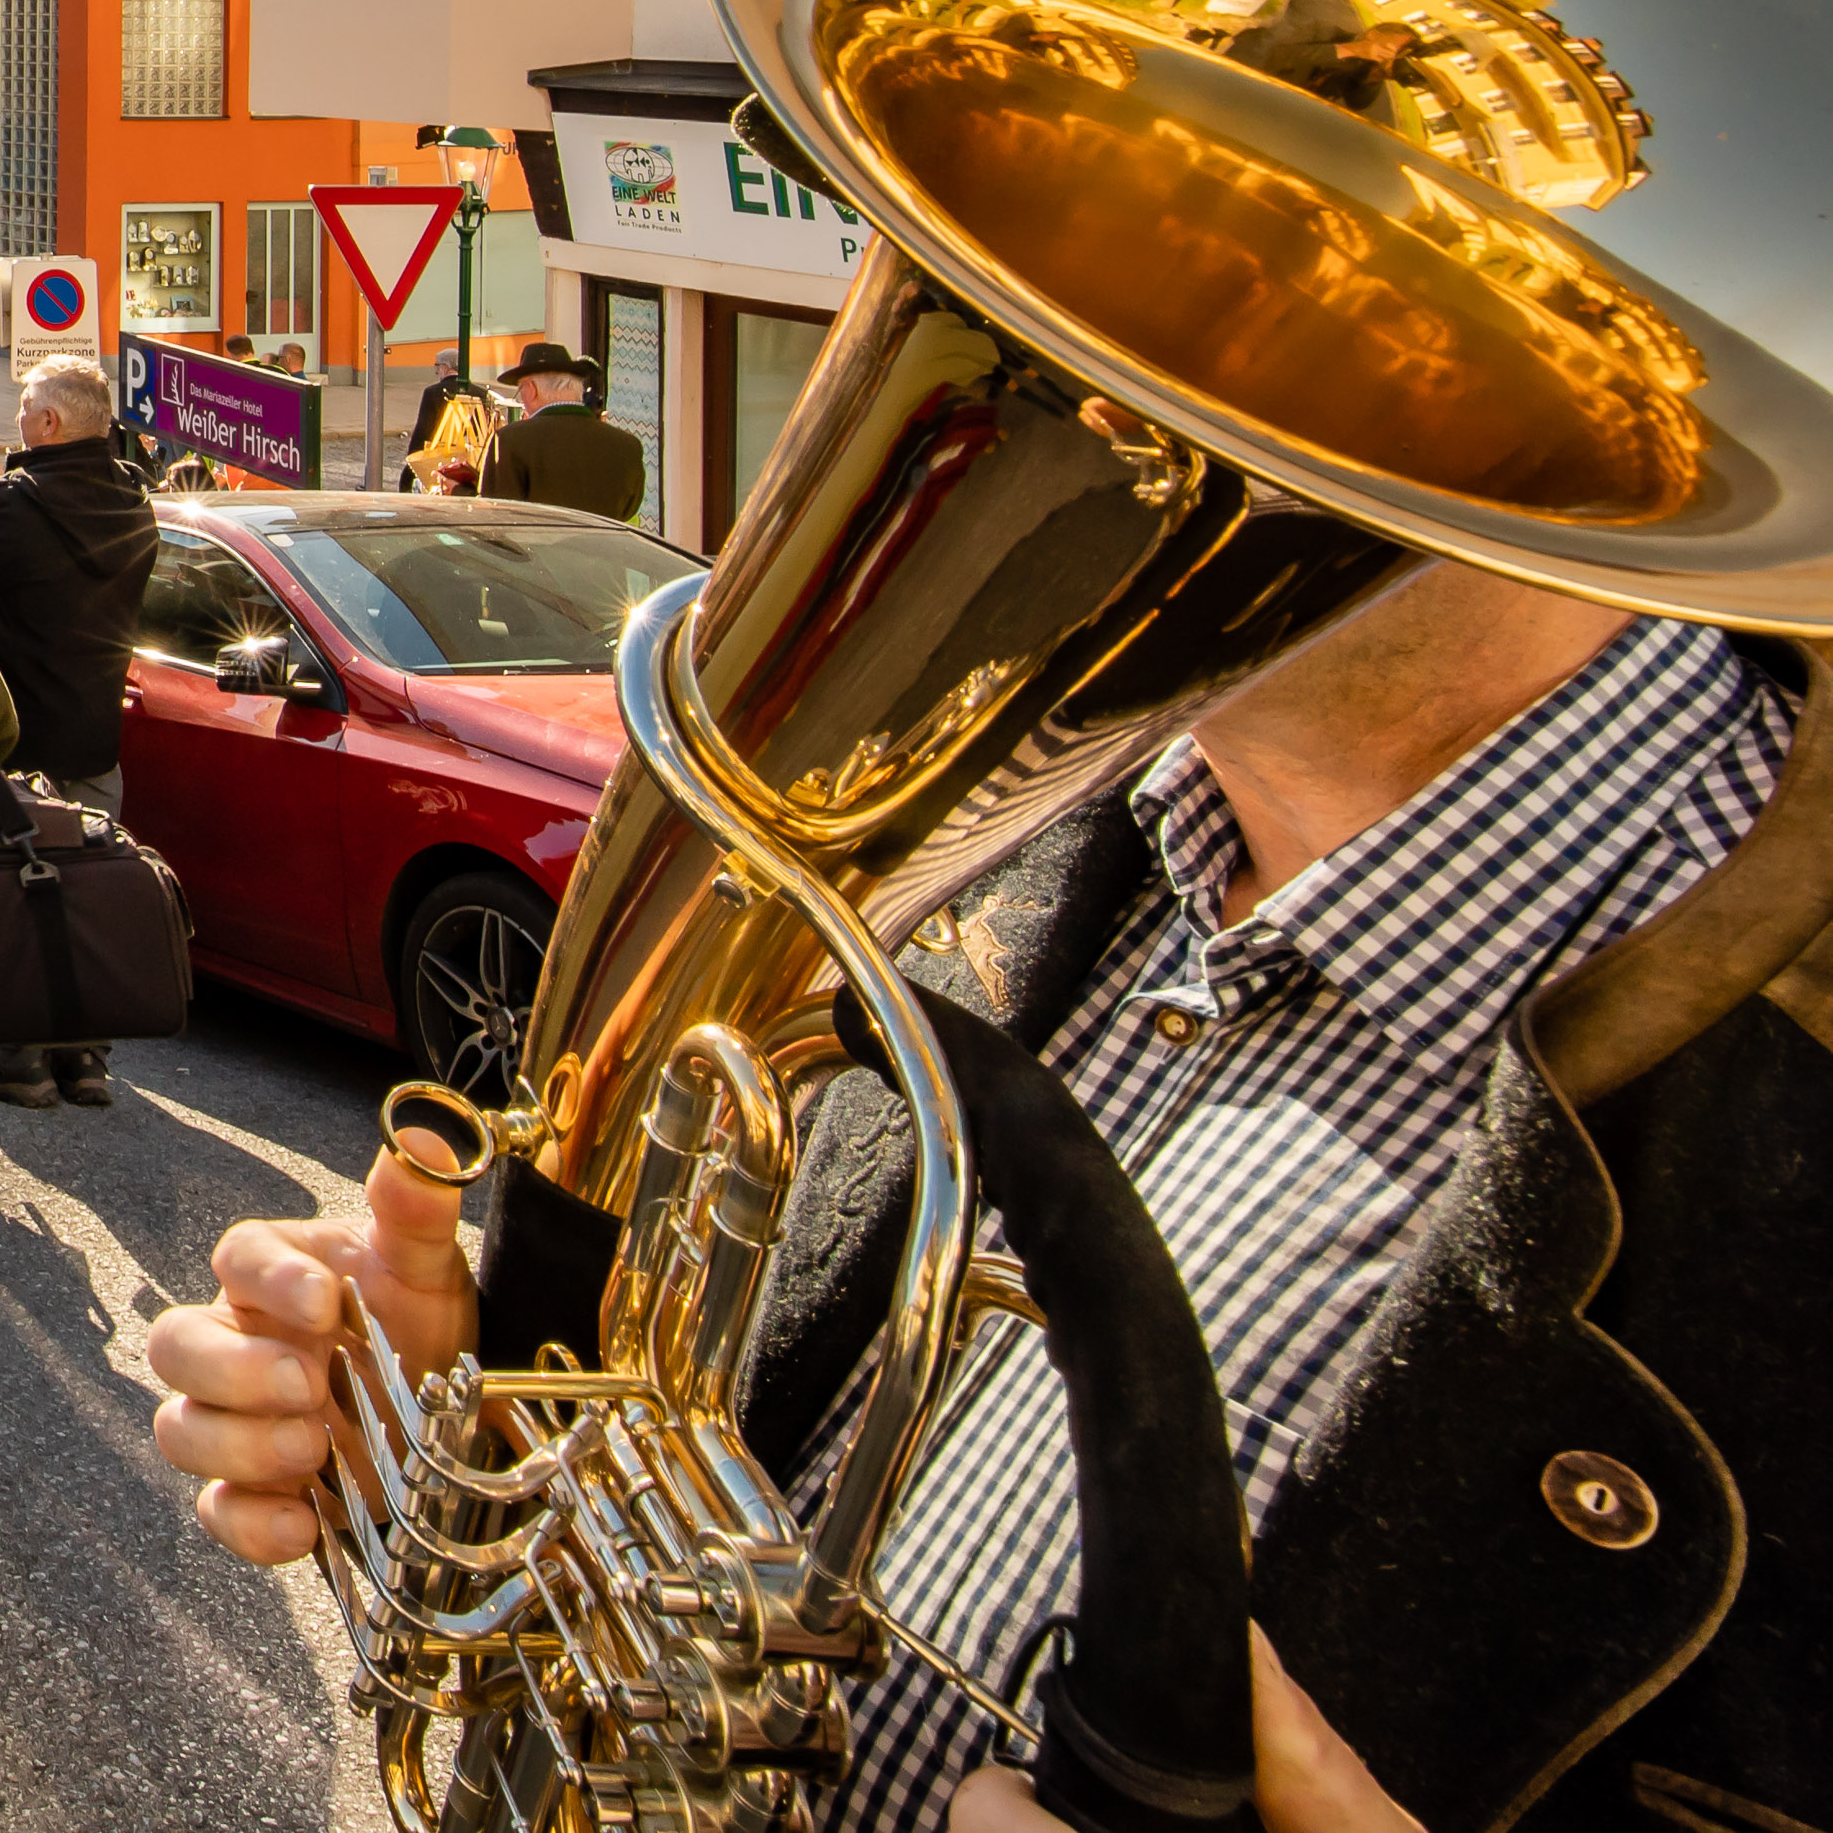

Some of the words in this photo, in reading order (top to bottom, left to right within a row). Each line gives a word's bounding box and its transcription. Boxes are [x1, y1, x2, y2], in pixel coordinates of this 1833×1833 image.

[611, 185, 640, 200] EINE
[643, 188, 676, 204] WELT
[615, 204, 680, 223] LADEN
[840, 237, 864, 262] P
[19, 337, 93, 346] Gebührenpflichtige
[127, 347, 146, 408] P
[189, 382, 202, 398] Das
[203, 389, 241, 411] Mariazeller
[242, 399, 263, 417] Hotel
[177, 402, 237, 450] Weißer
[242, 422, 300, 472] Hirsch
